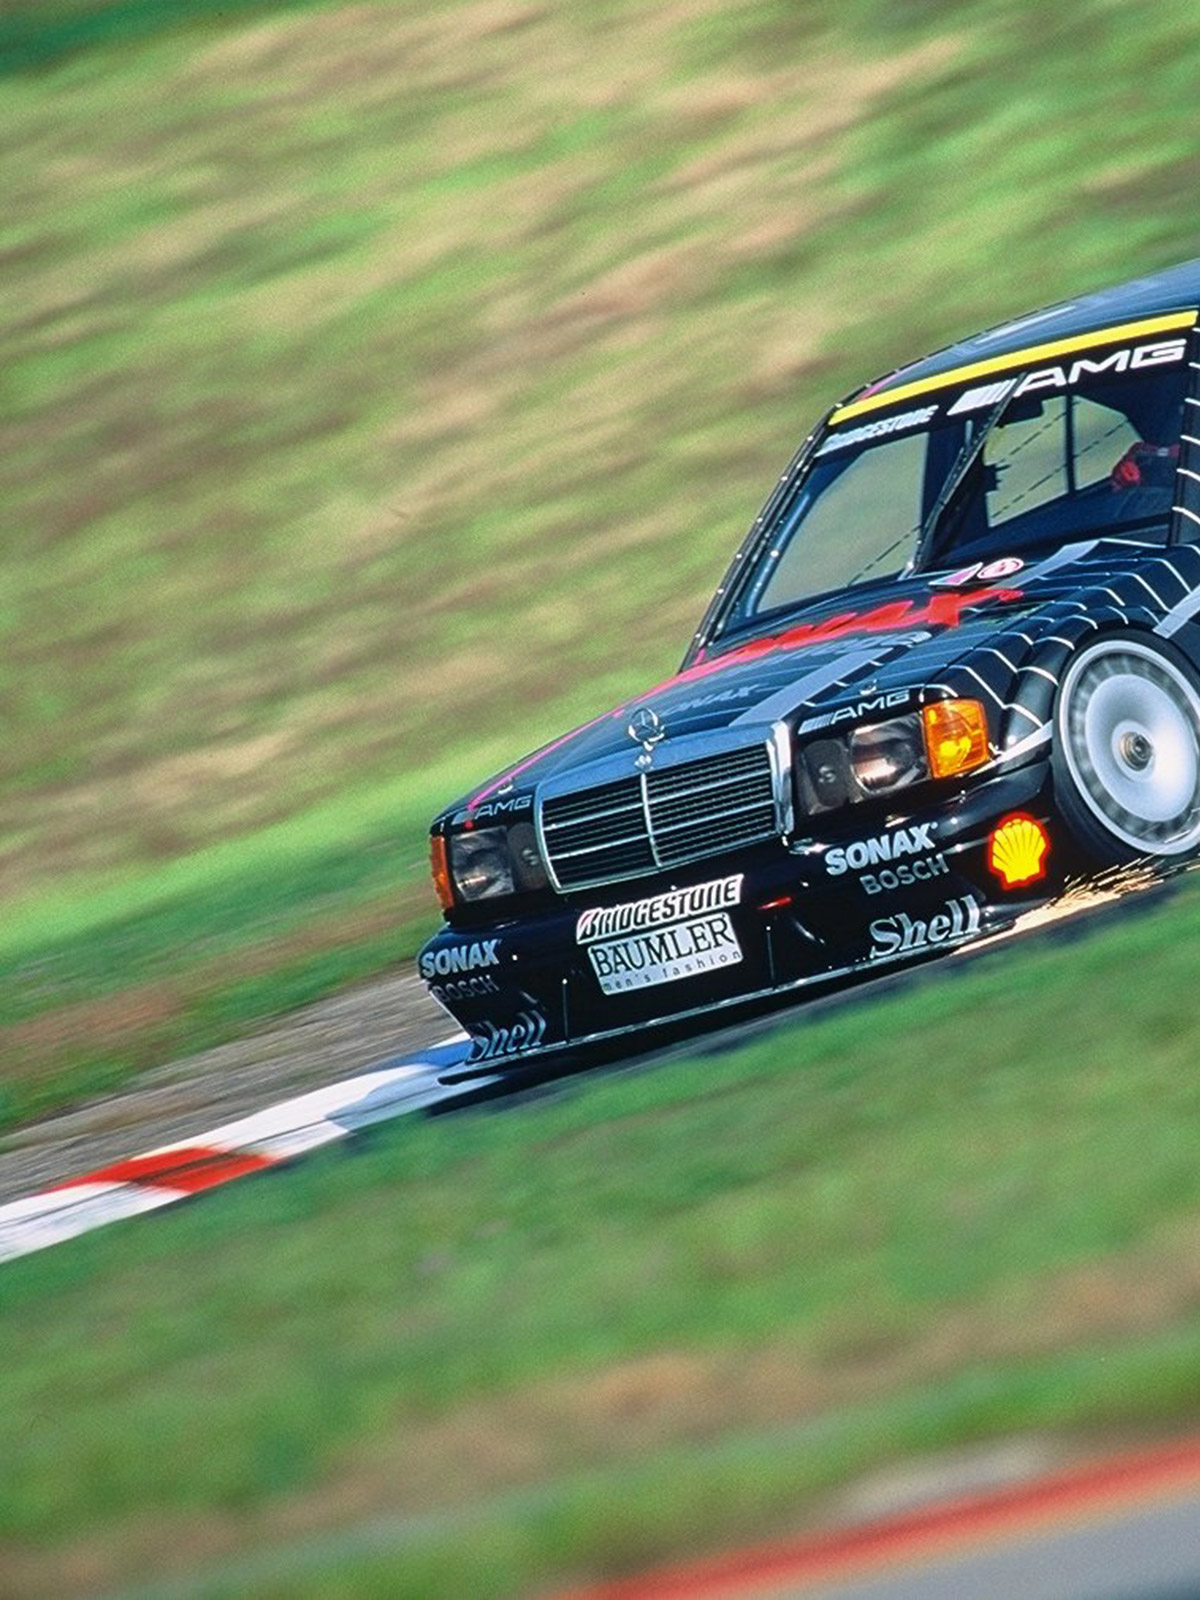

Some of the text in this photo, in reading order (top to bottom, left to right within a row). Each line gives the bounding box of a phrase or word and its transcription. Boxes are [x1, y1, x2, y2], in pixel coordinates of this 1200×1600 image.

[1012, 338, 1188, 398] AMG
[830, 689, 910, 725] AMG
[474, 794, 533, 820] AMG
[824, 824, 936, 876] SONAX
[859, 854, 949, 895] BOSCH
[578, 875, 741, 942] BRIDGESTONE
[869, 894, 981, 958] Shell
[421, 939, 500, 978] SONAX
[602, 950, 742, 992] men's fashion
[431, 975, 500, 1002] BOSCH
[465, 1010, 547, 1062] Shell
